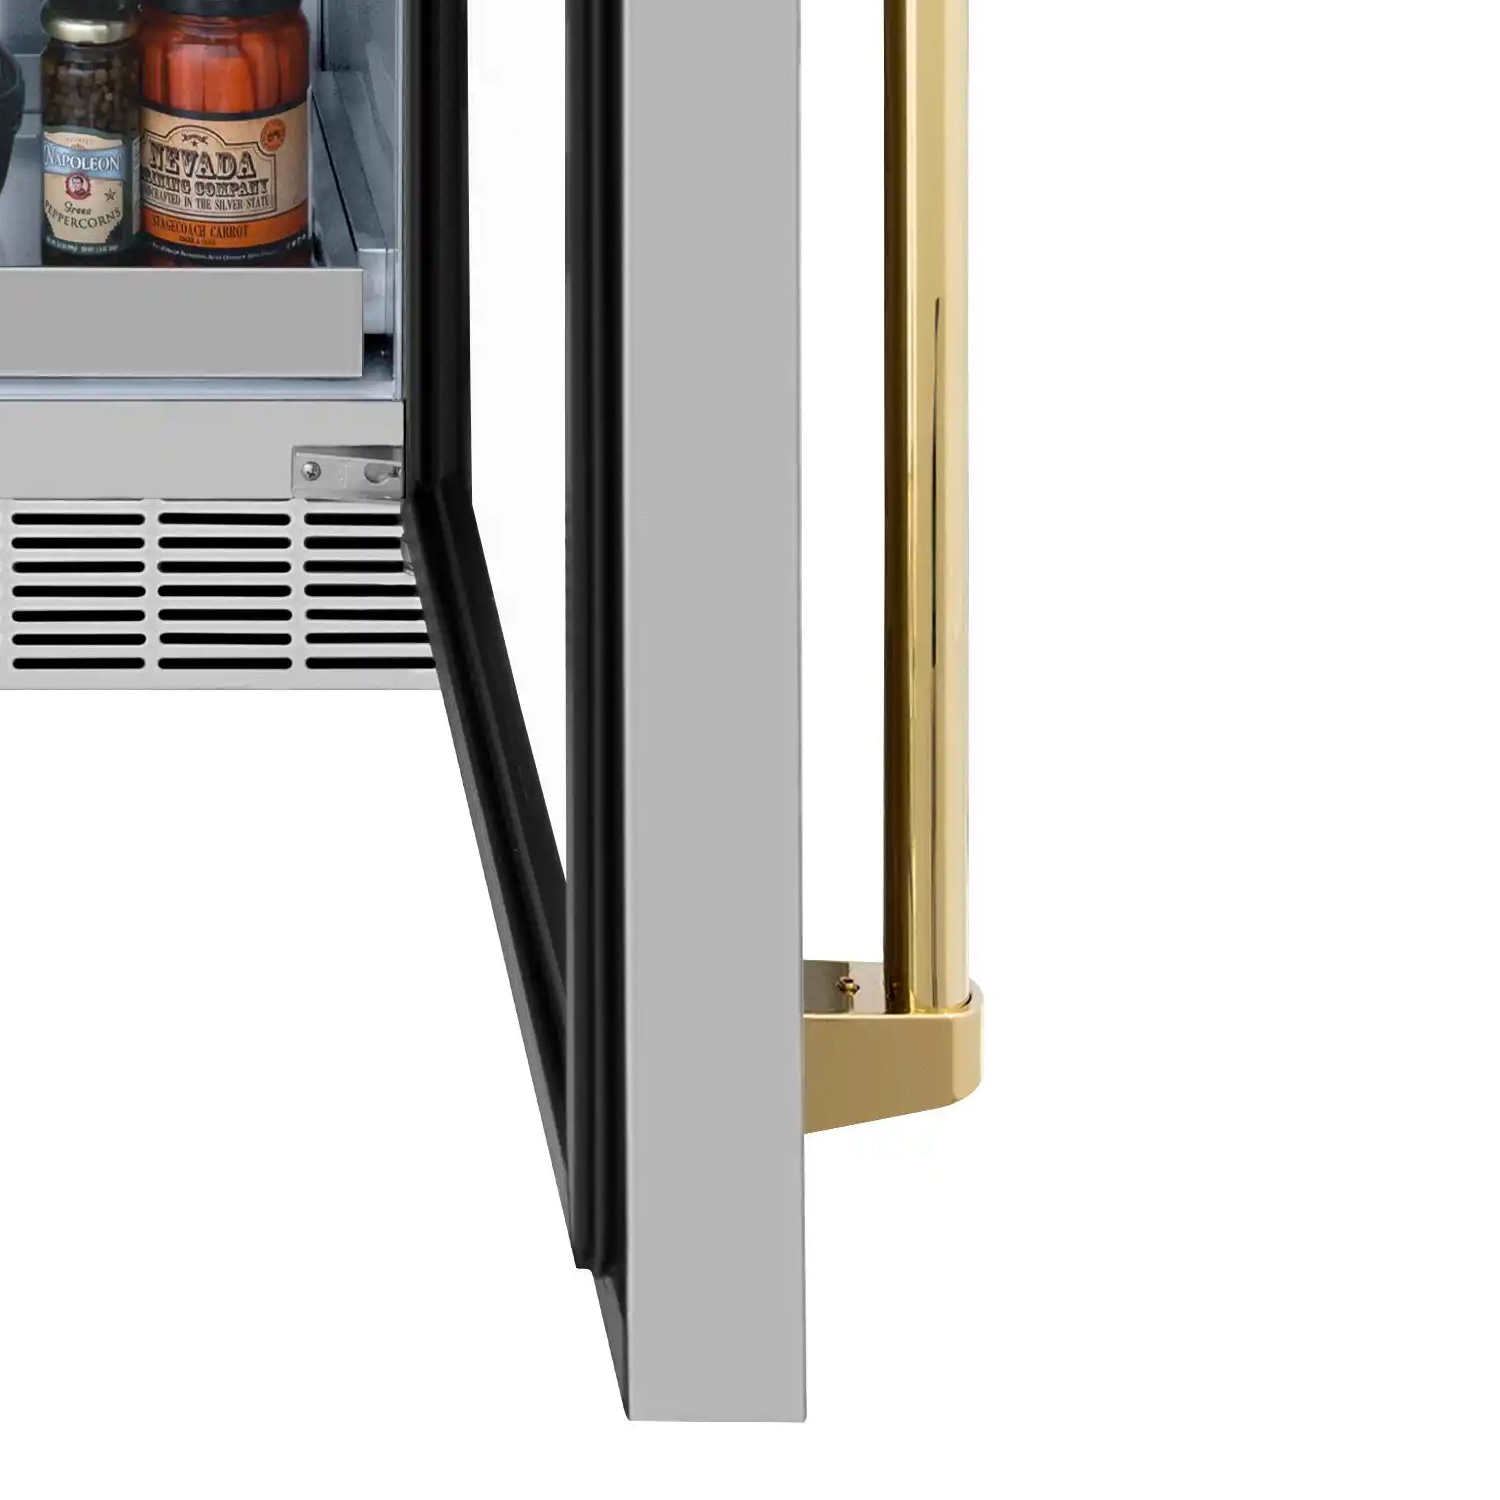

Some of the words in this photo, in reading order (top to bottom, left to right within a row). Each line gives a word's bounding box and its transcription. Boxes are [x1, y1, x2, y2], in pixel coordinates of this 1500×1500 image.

[44, 144, 120, 171] NAPOLEON
[149, 140, 257, 180] NEVADA
[194, 178, 269, 198] COMPANY
[45, 199, 121, 229] PEPPERCORNS
[184, 196, 192, 208] IN
[196, 198, 212, 210] THE
[214, 198, 244, 211] SILVER
[246, 195, 269, 209] STATE
[152, 215, 206, 237] STAGECOACH
[210, 224, 249, 239] CARROT
